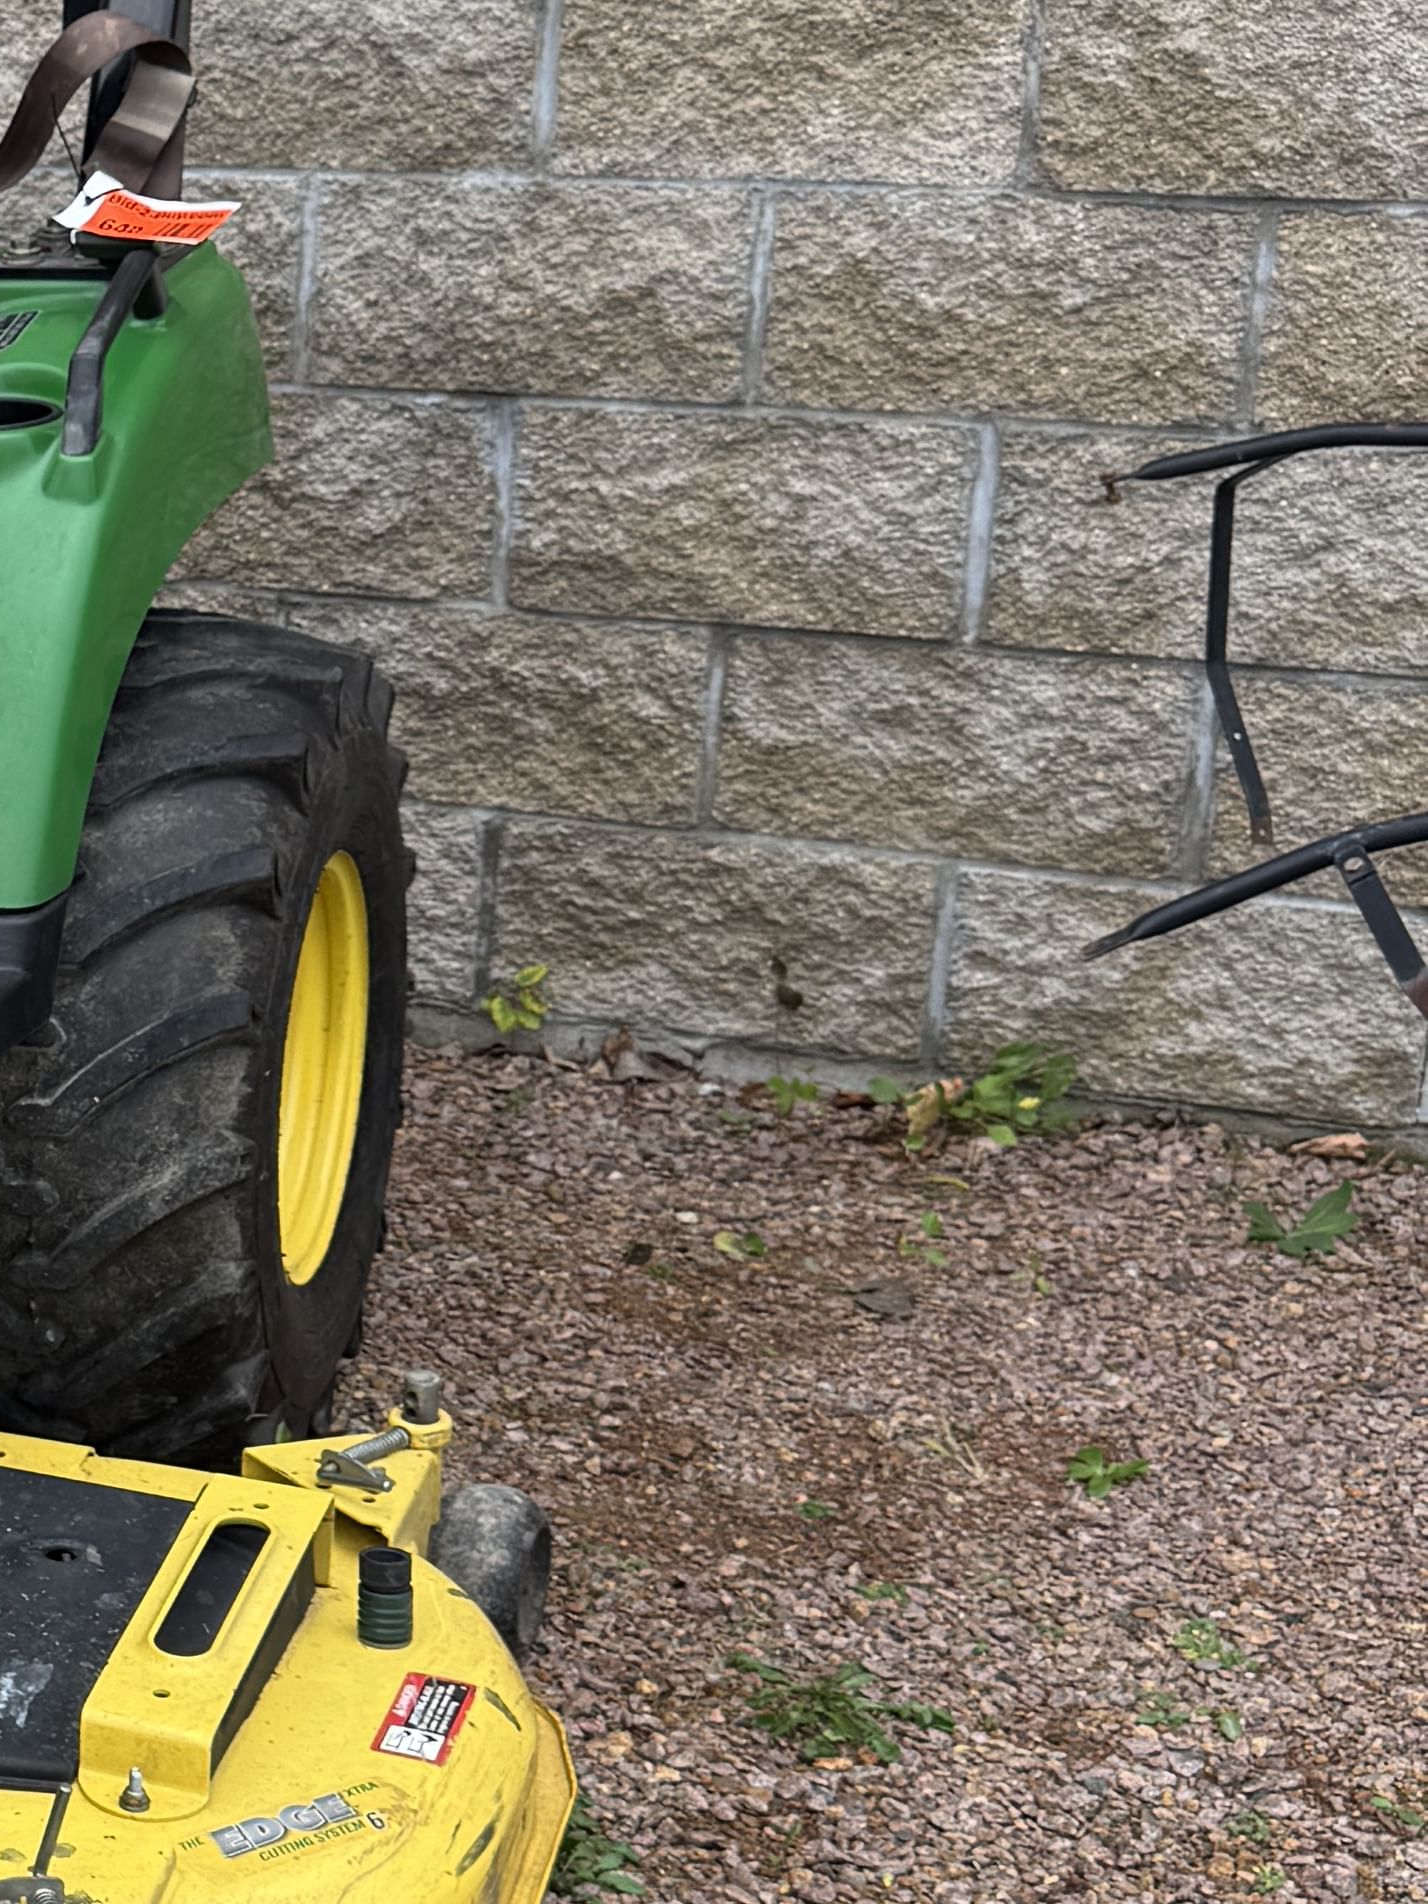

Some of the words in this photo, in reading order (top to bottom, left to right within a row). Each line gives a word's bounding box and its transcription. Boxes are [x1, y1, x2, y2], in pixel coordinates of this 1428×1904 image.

[177, 1836, 206, 1851] THE
[210, 1792, 356, 1859] EDGE
[344, 1781, 380, 1797] XTRA
[259, 1836, 314, 1862] CUTTING
[316, 1819, 366, 1843] SYSTEM
[365, 1811, 386, 1831] 6
